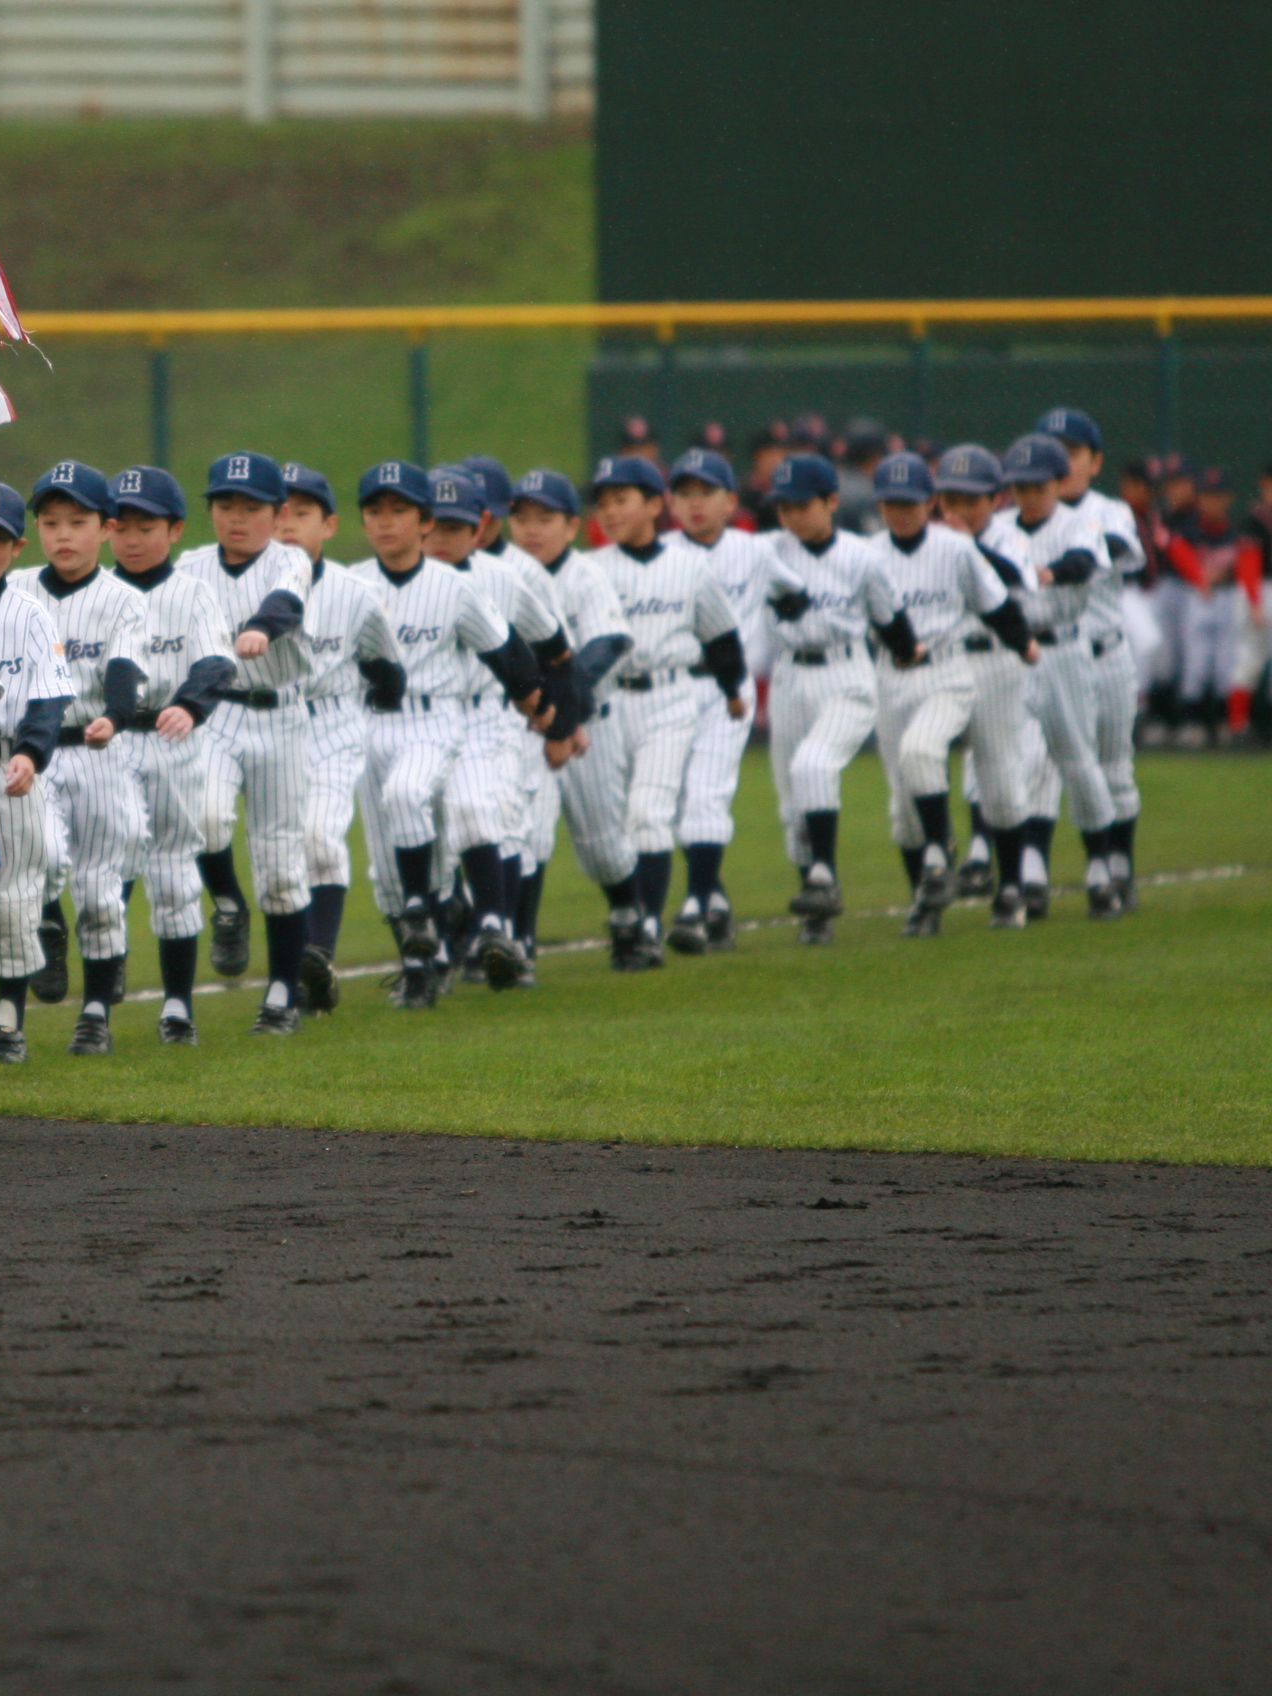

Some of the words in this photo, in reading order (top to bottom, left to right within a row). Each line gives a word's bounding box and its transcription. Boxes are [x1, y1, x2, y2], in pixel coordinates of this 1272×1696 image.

[51, 462, 74, 483] H
[228, 456, 249, 479] H
[120, 471, 141, 493] H
